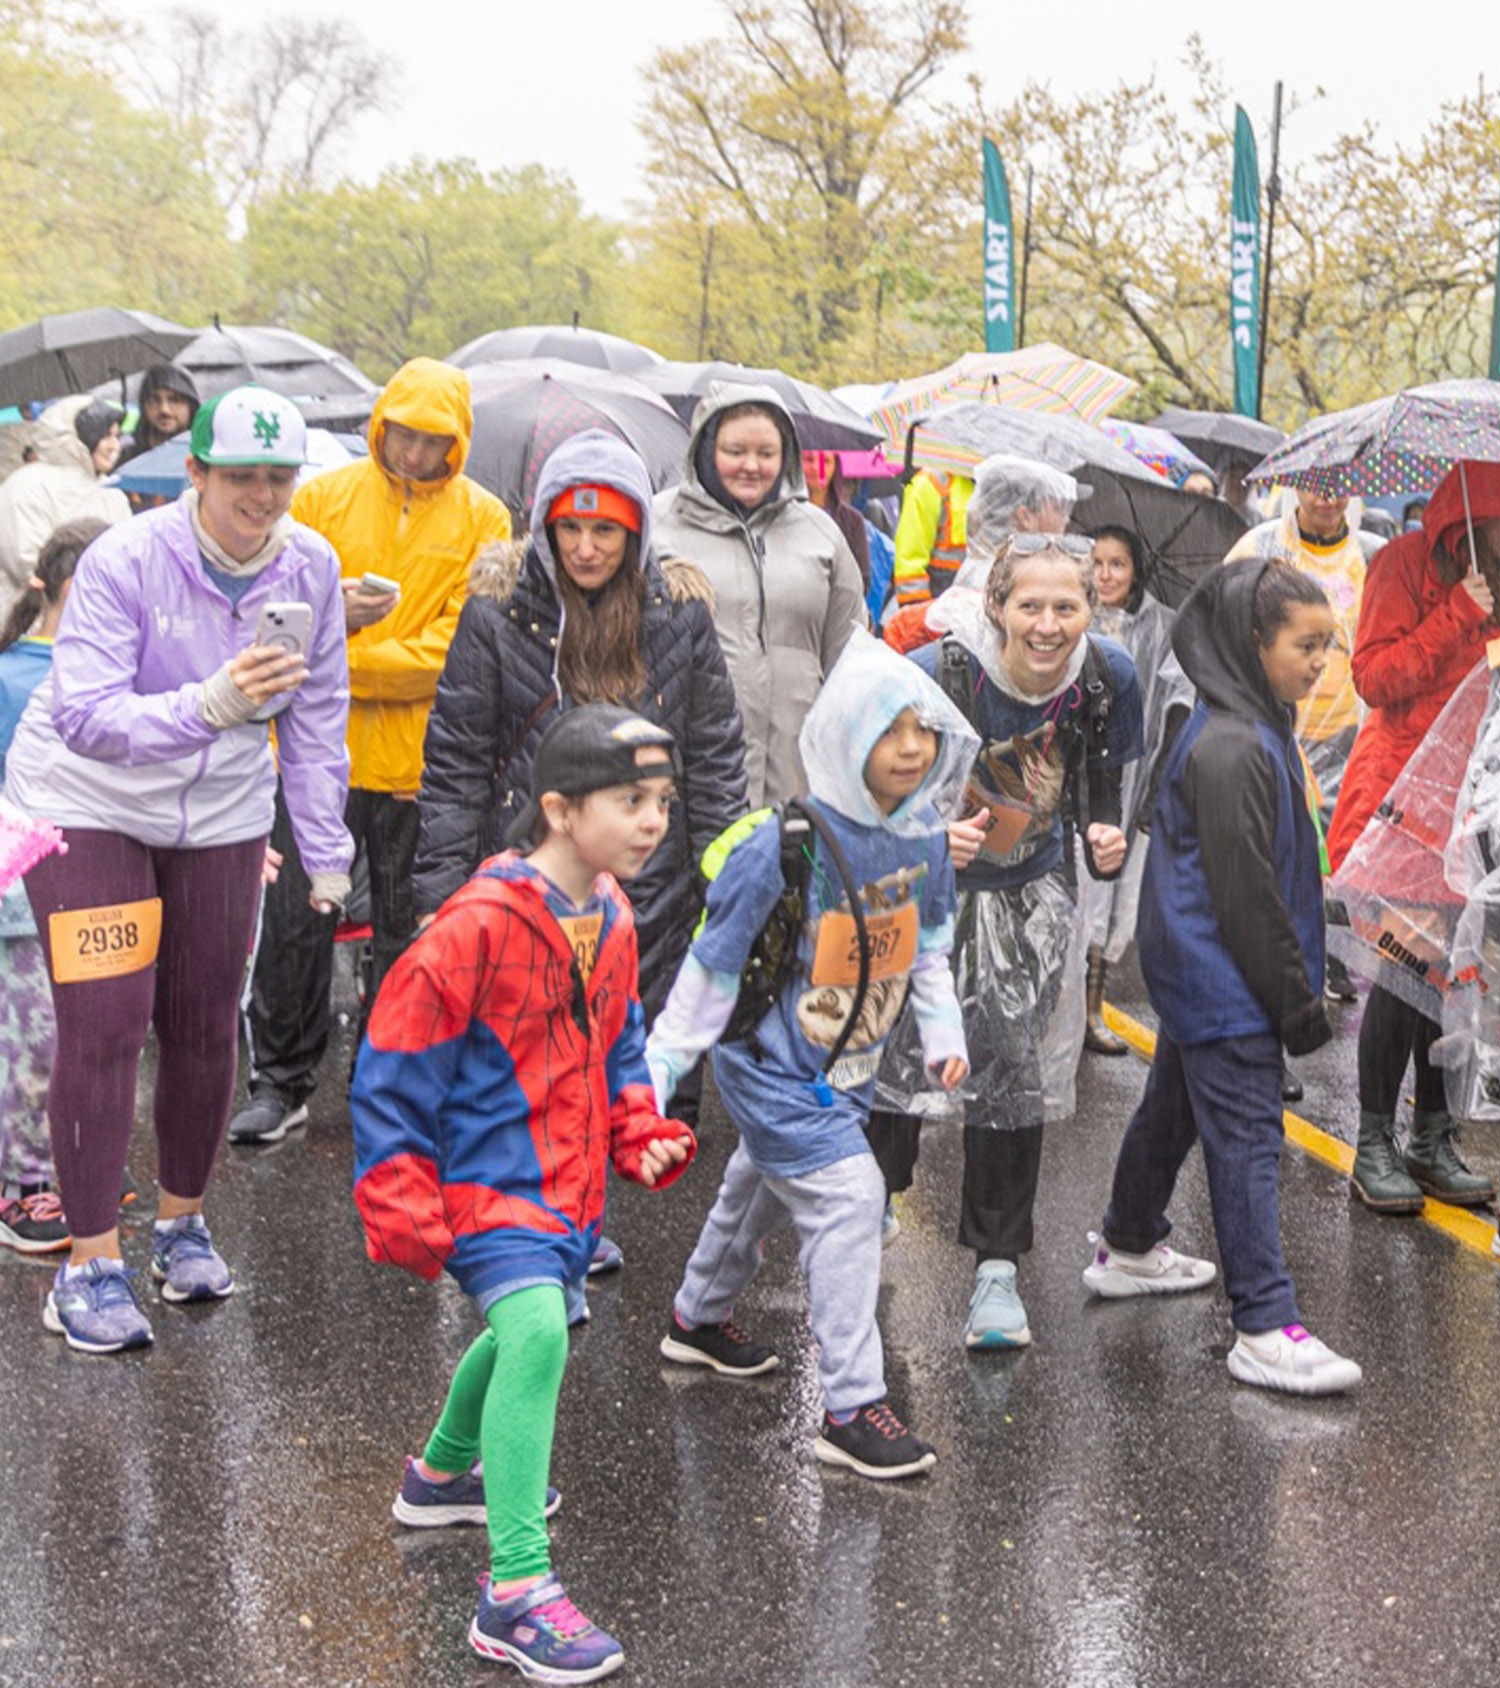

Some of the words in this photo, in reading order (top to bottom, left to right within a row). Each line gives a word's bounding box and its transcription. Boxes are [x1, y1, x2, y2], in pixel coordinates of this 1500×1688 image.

[986, 217, 1010, 323] START
[1231, 214, 1258, 350] START
[77, 920, 140, 955] 2938
